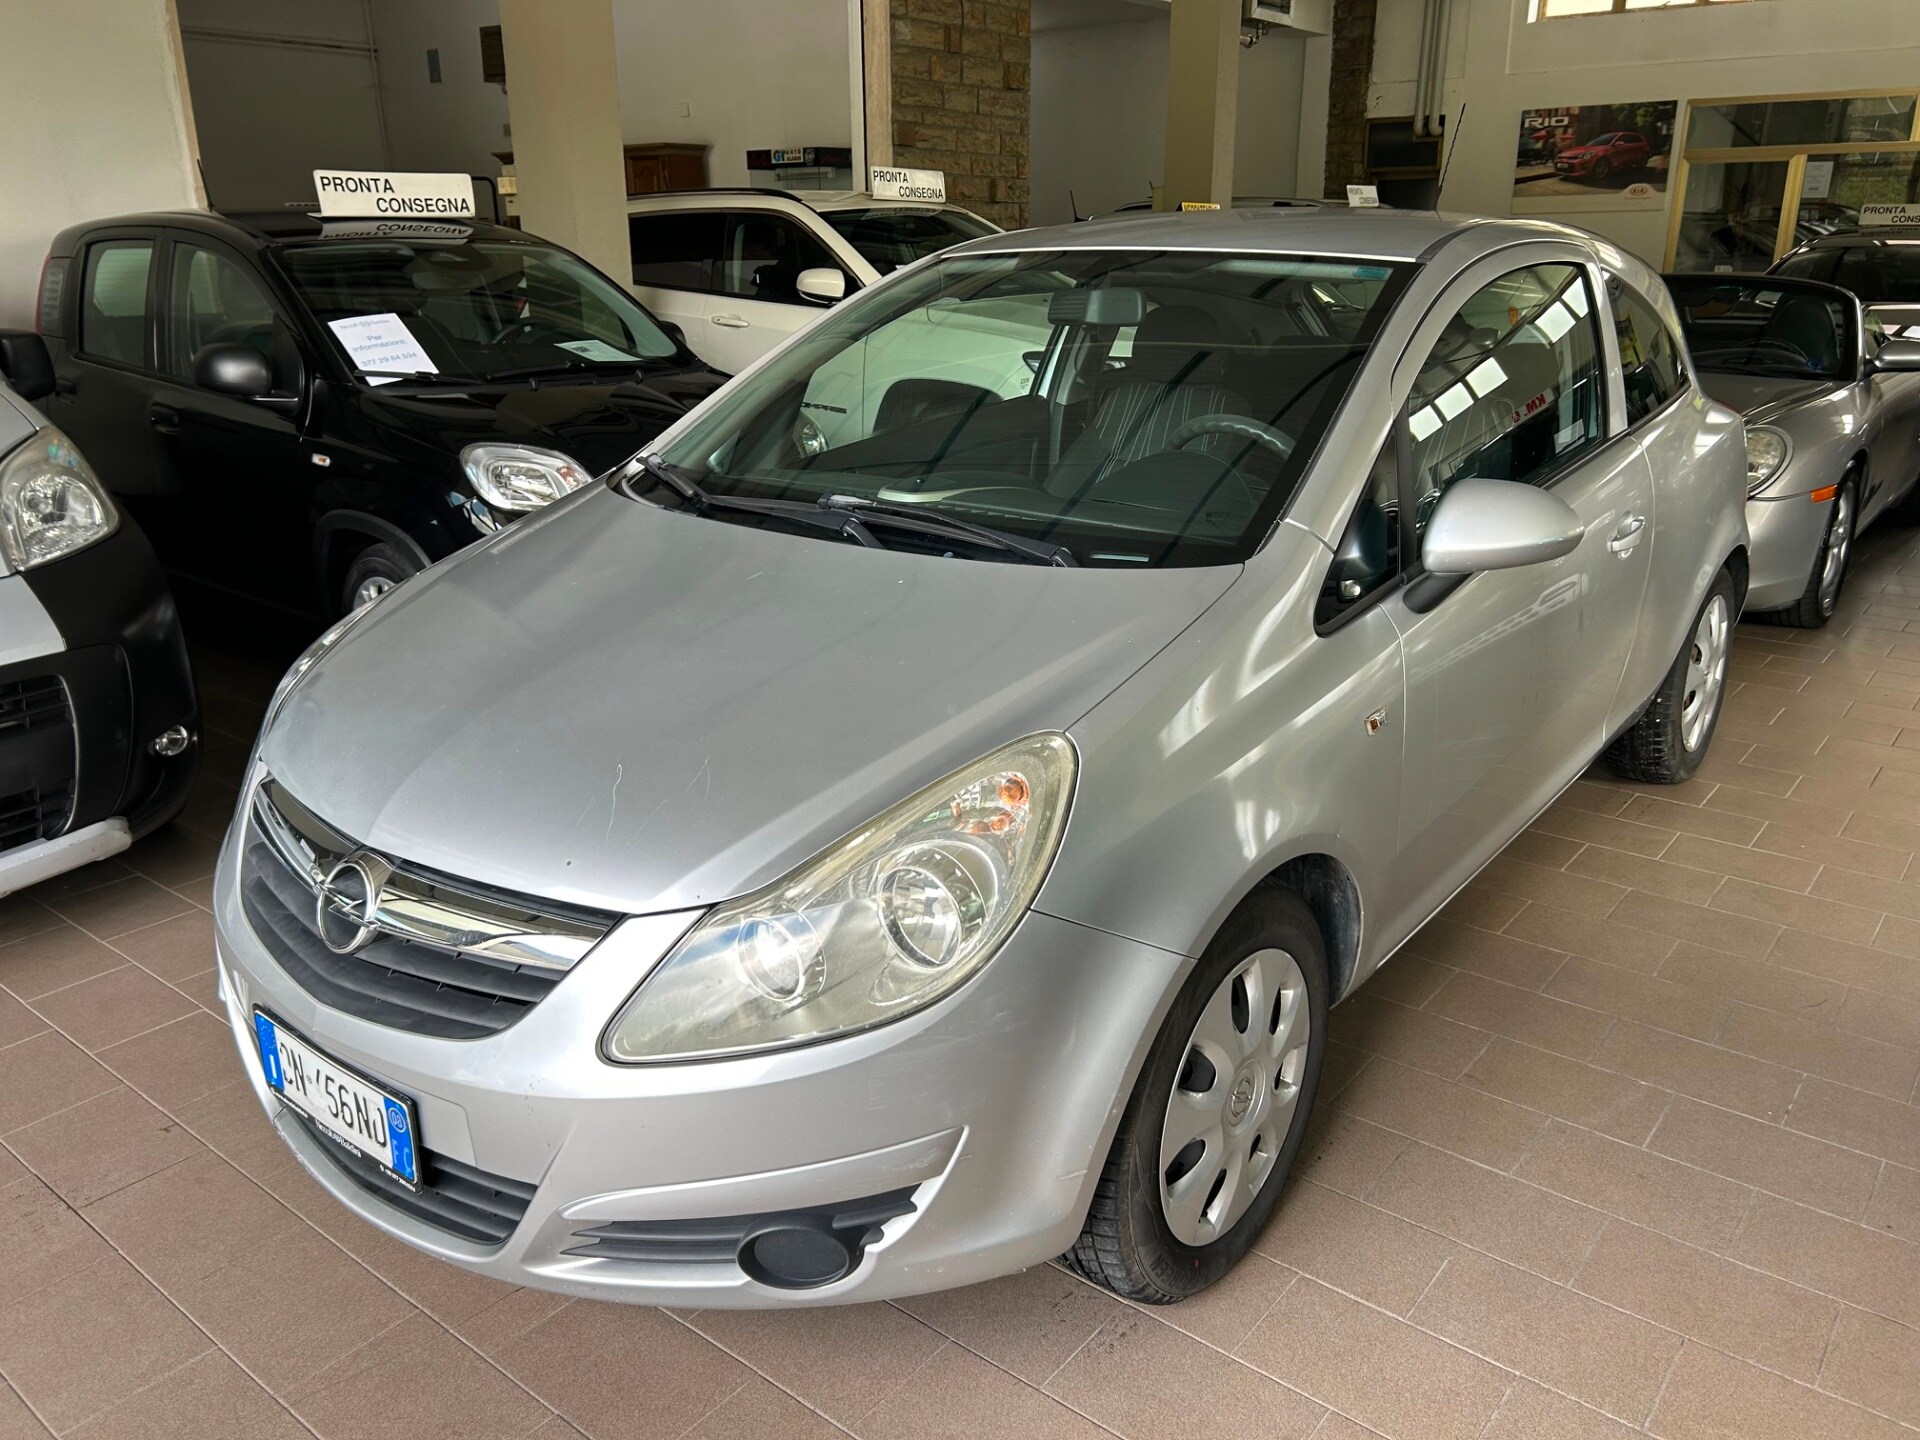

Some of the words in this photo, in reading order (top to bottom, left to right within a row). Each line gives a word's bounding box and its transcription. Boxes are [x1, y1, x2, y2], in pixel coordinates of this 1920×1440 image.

[1524, 116, 1569, 129] RIO
[873, 170, 909, 184] PRONTA
[320, 176, 395, 194] PRONTA
[898, 186, 944, 199] CONSEGNA
[376, 197, 470, 213] CONSEGNA
[1863, 206, 1906, 214] PRONTA
